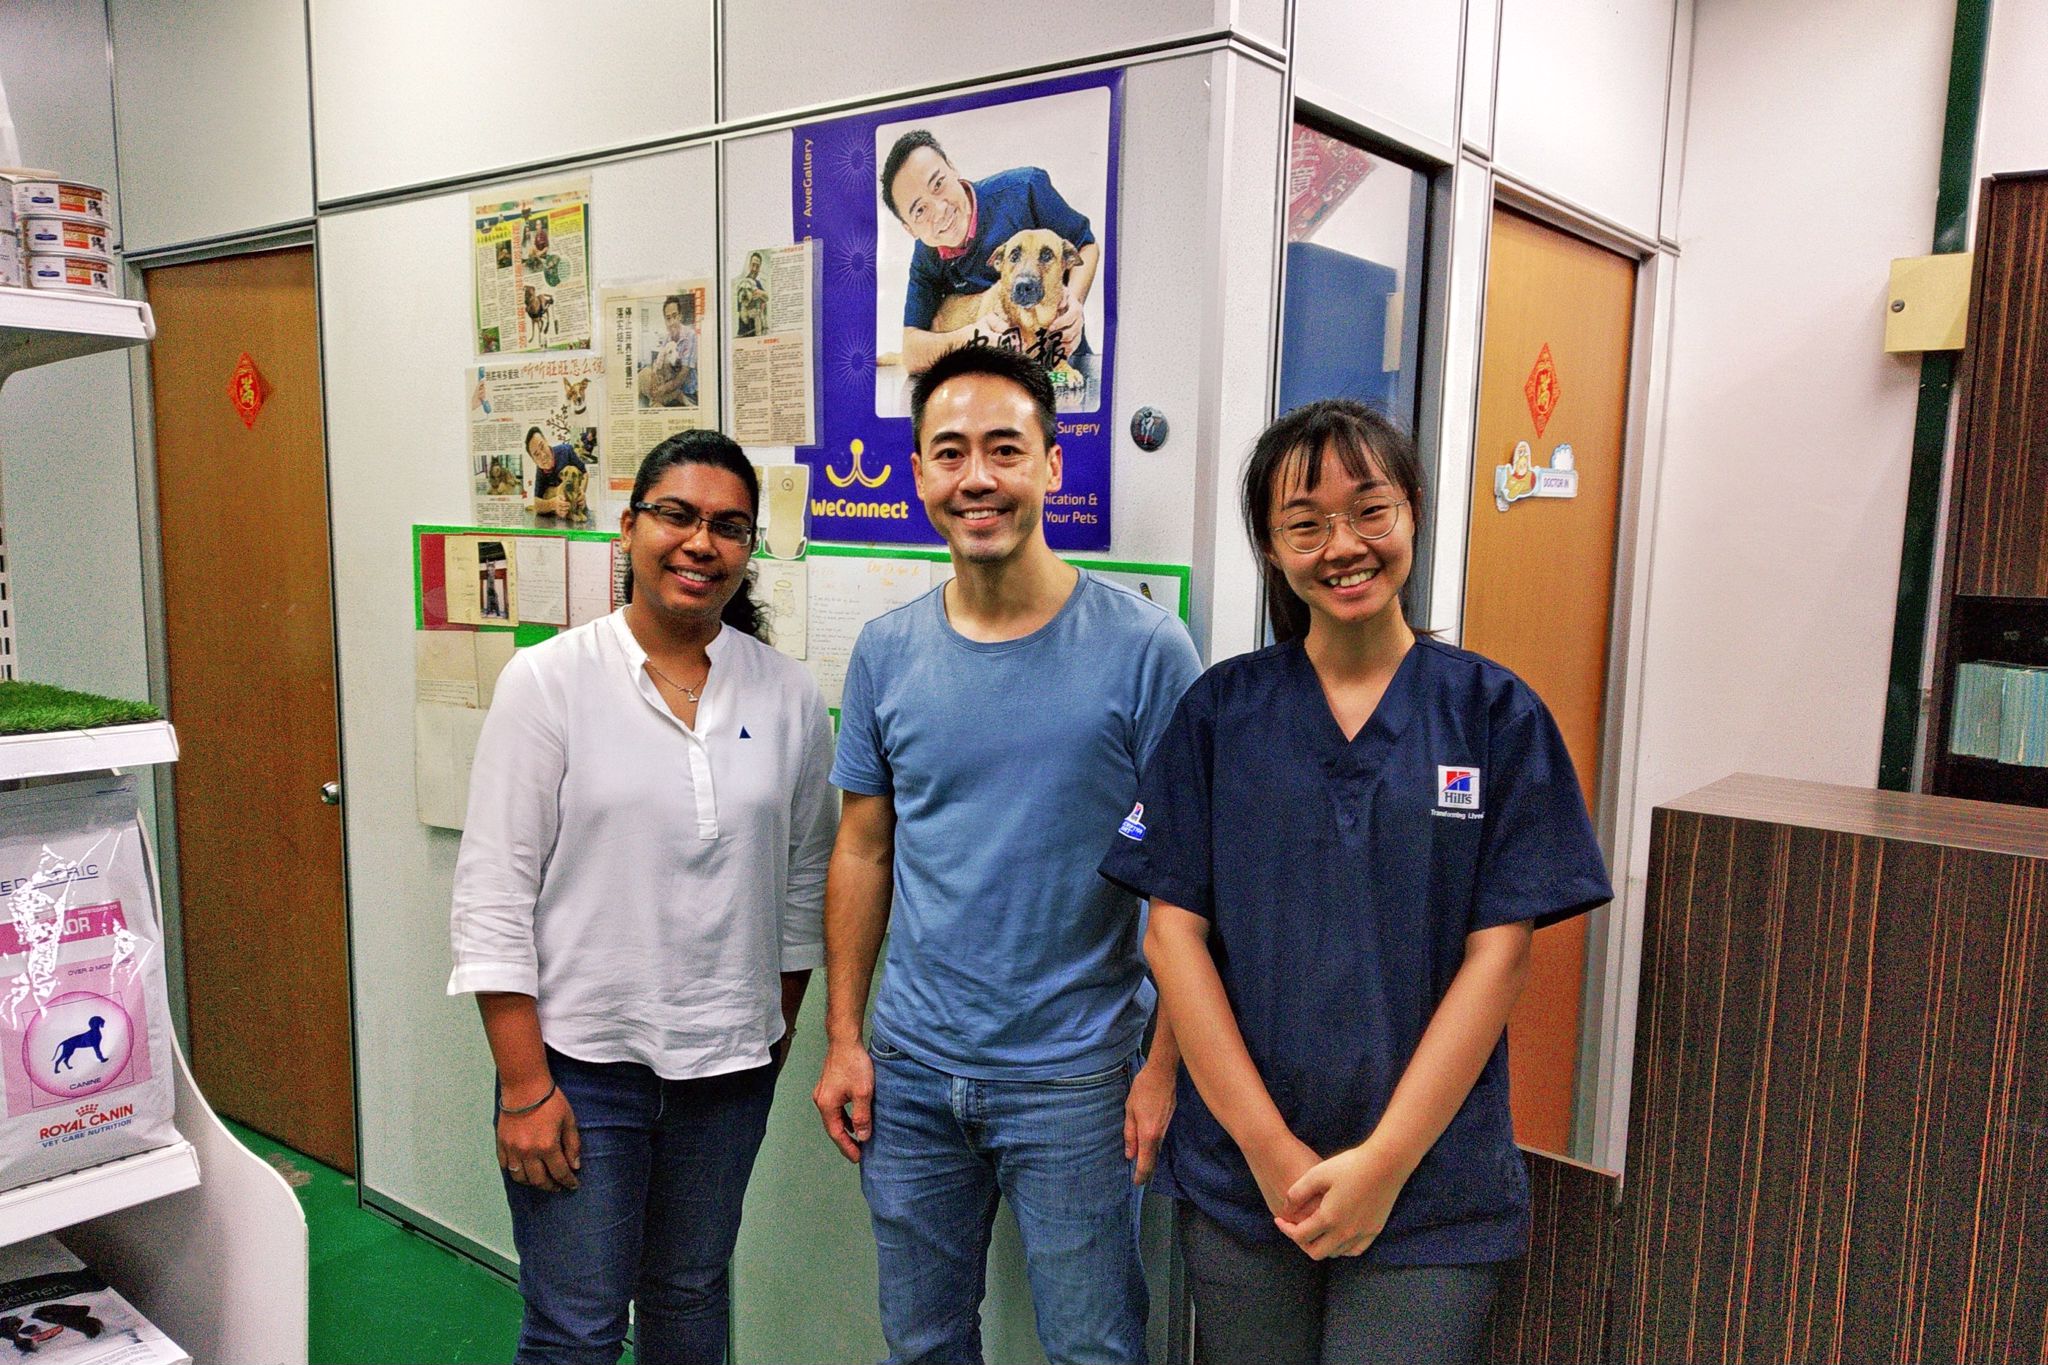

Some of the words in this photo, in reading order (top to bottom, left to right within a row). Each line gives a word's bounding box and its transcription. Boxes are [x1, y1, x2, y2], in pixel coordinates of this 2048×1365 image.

[803, 138, 814, 217] AweGallery
[1057, 421, 1101, 436] Surgery
[1043, 492, 1086, 506] nication
[1088, 493, 1098, 506] &
[810, 498, 909, 519] WeConnect
[1045, 511, 1071, 524] Your
[1072, 511, 1098, 524] Pets
[68, 967, 88, 977] OVER
[88, 966, 95, 974] 2
[69, 1077, 102, 1091] CANINE
[39, 1119, 87, 1140] ROYAL
[89, 1103, 134, 1126] CANIN
[42, 1139, 60, 1149] VET
[61, 1132, 85, 1143] CARE
[87, 1119, 132, 1136] NUTRITION
